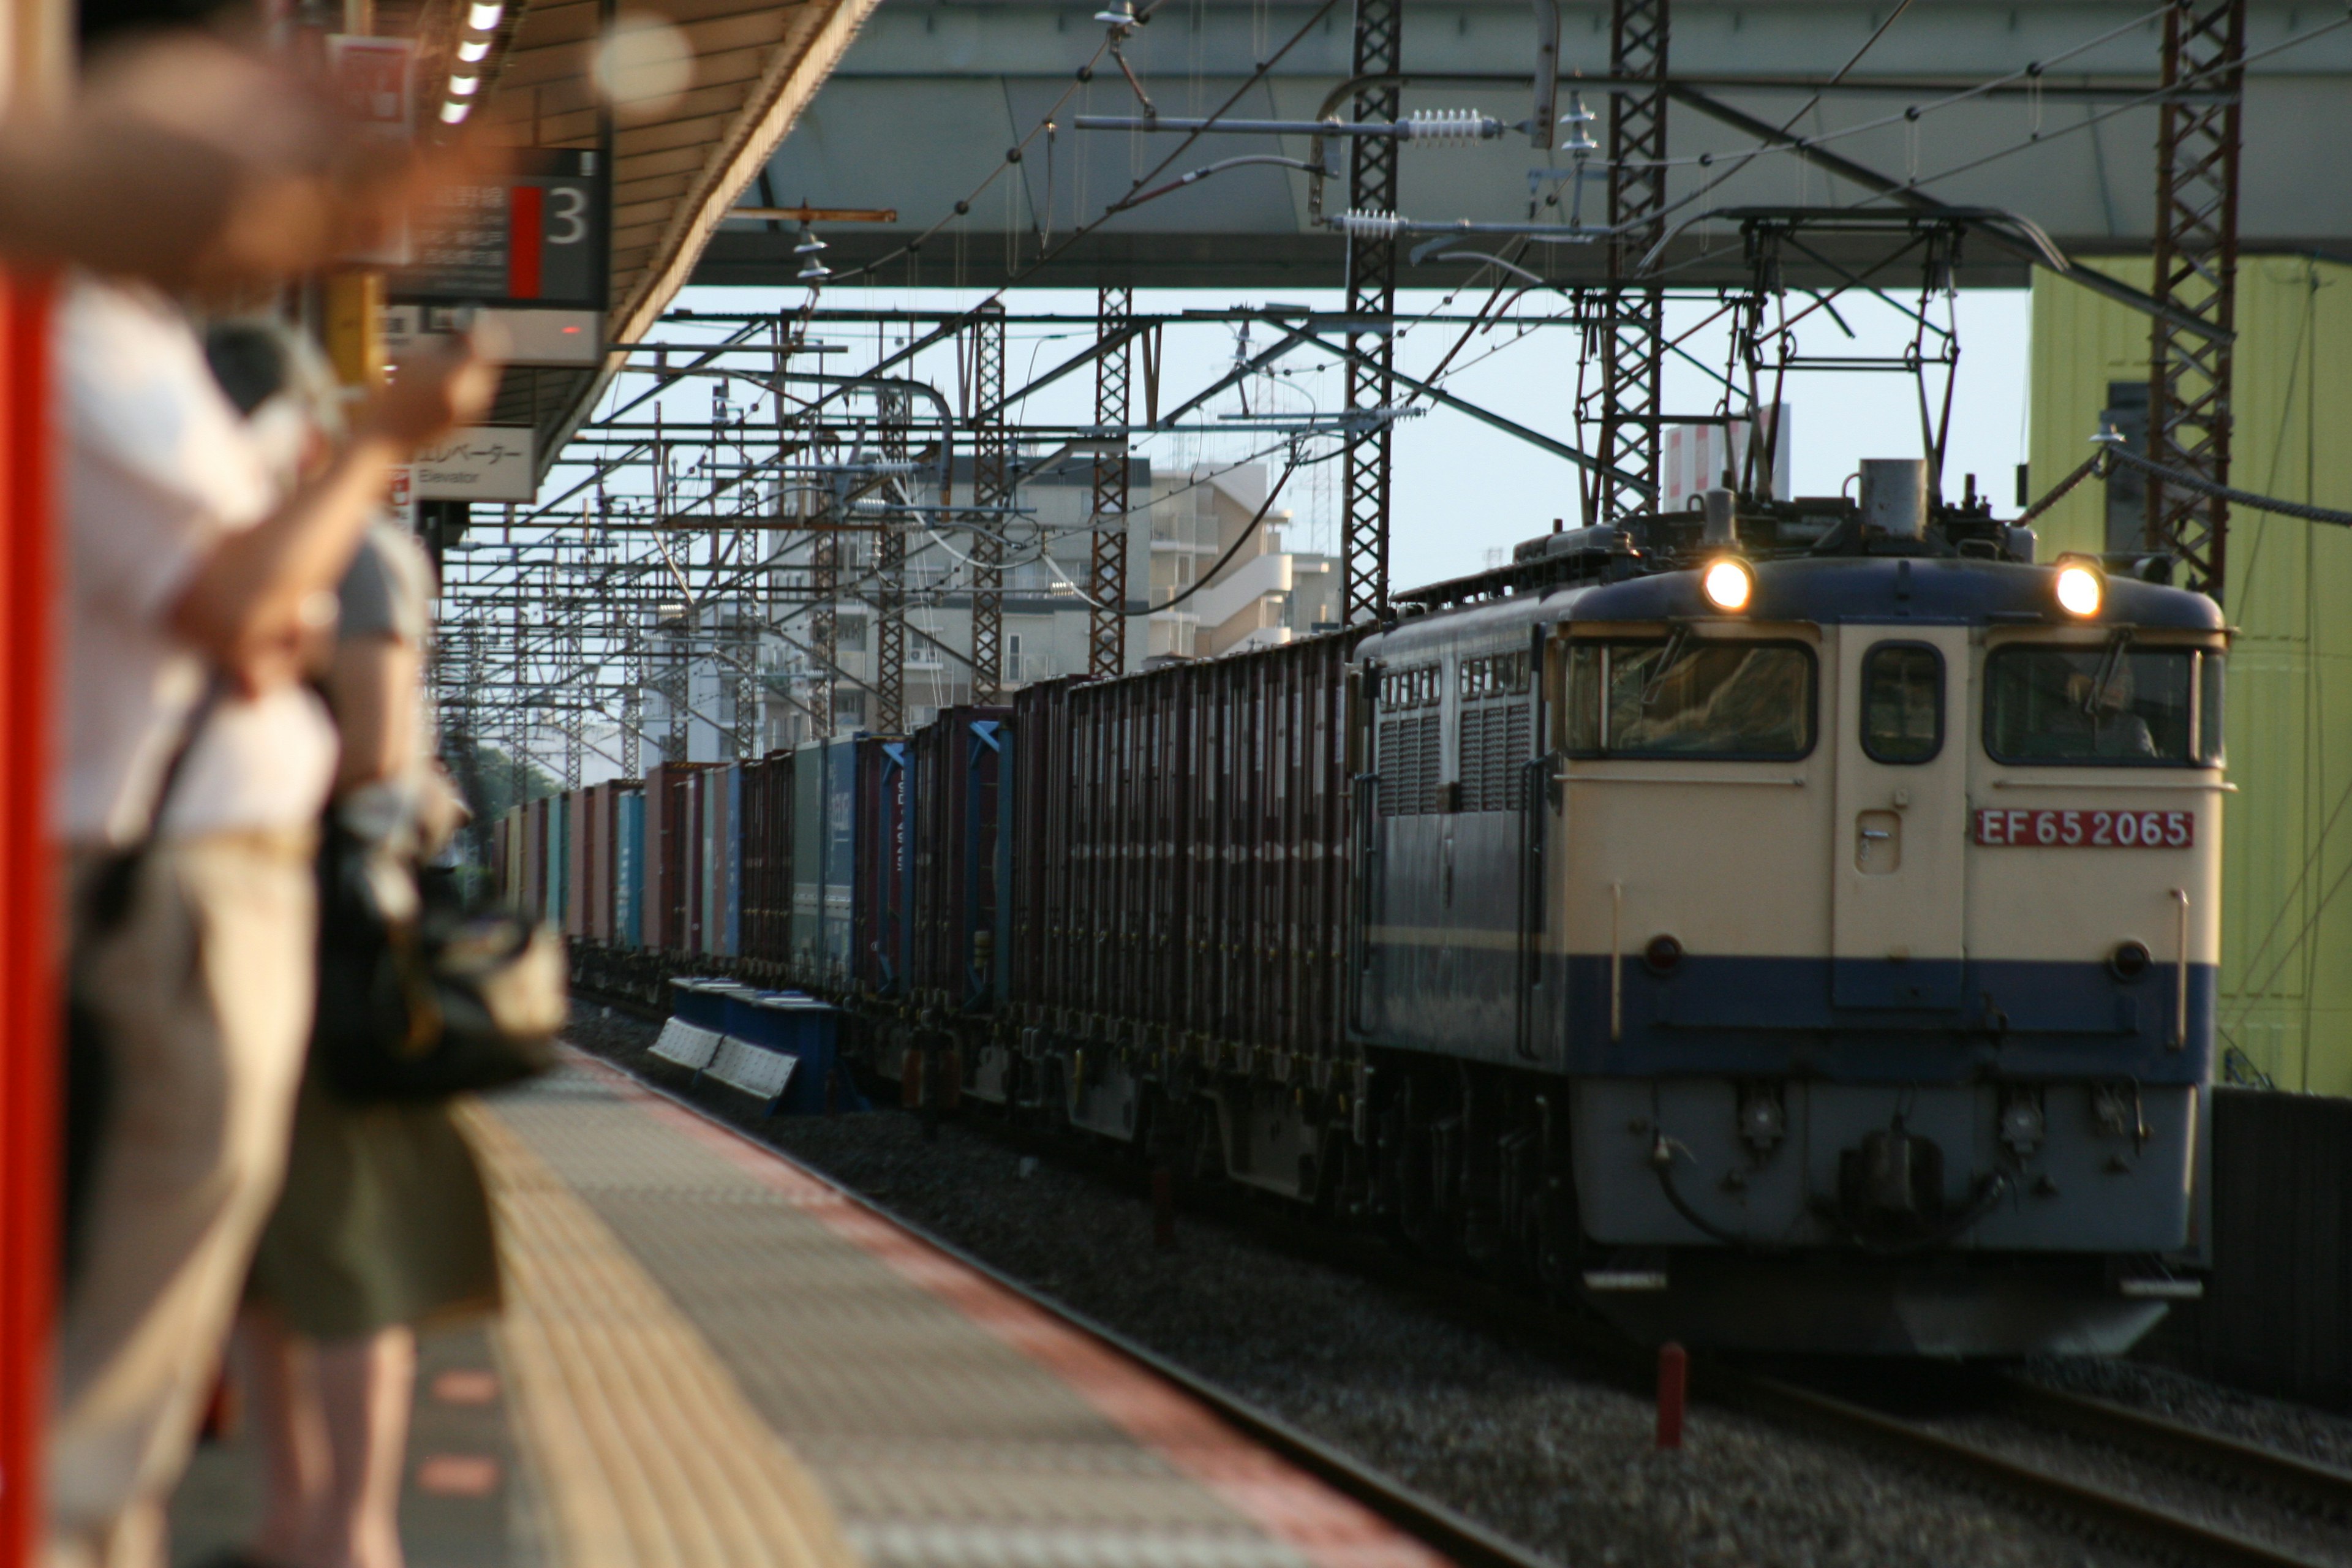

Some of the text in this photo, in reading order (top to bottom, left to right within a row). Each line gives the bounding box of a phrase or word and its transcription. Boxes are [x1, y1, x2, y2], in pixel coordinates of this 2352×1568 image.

[548, 187, 587, 244] 3
[419, 469, 479, 483] Elevator
[2092, 813, 2188, 846] 2065
